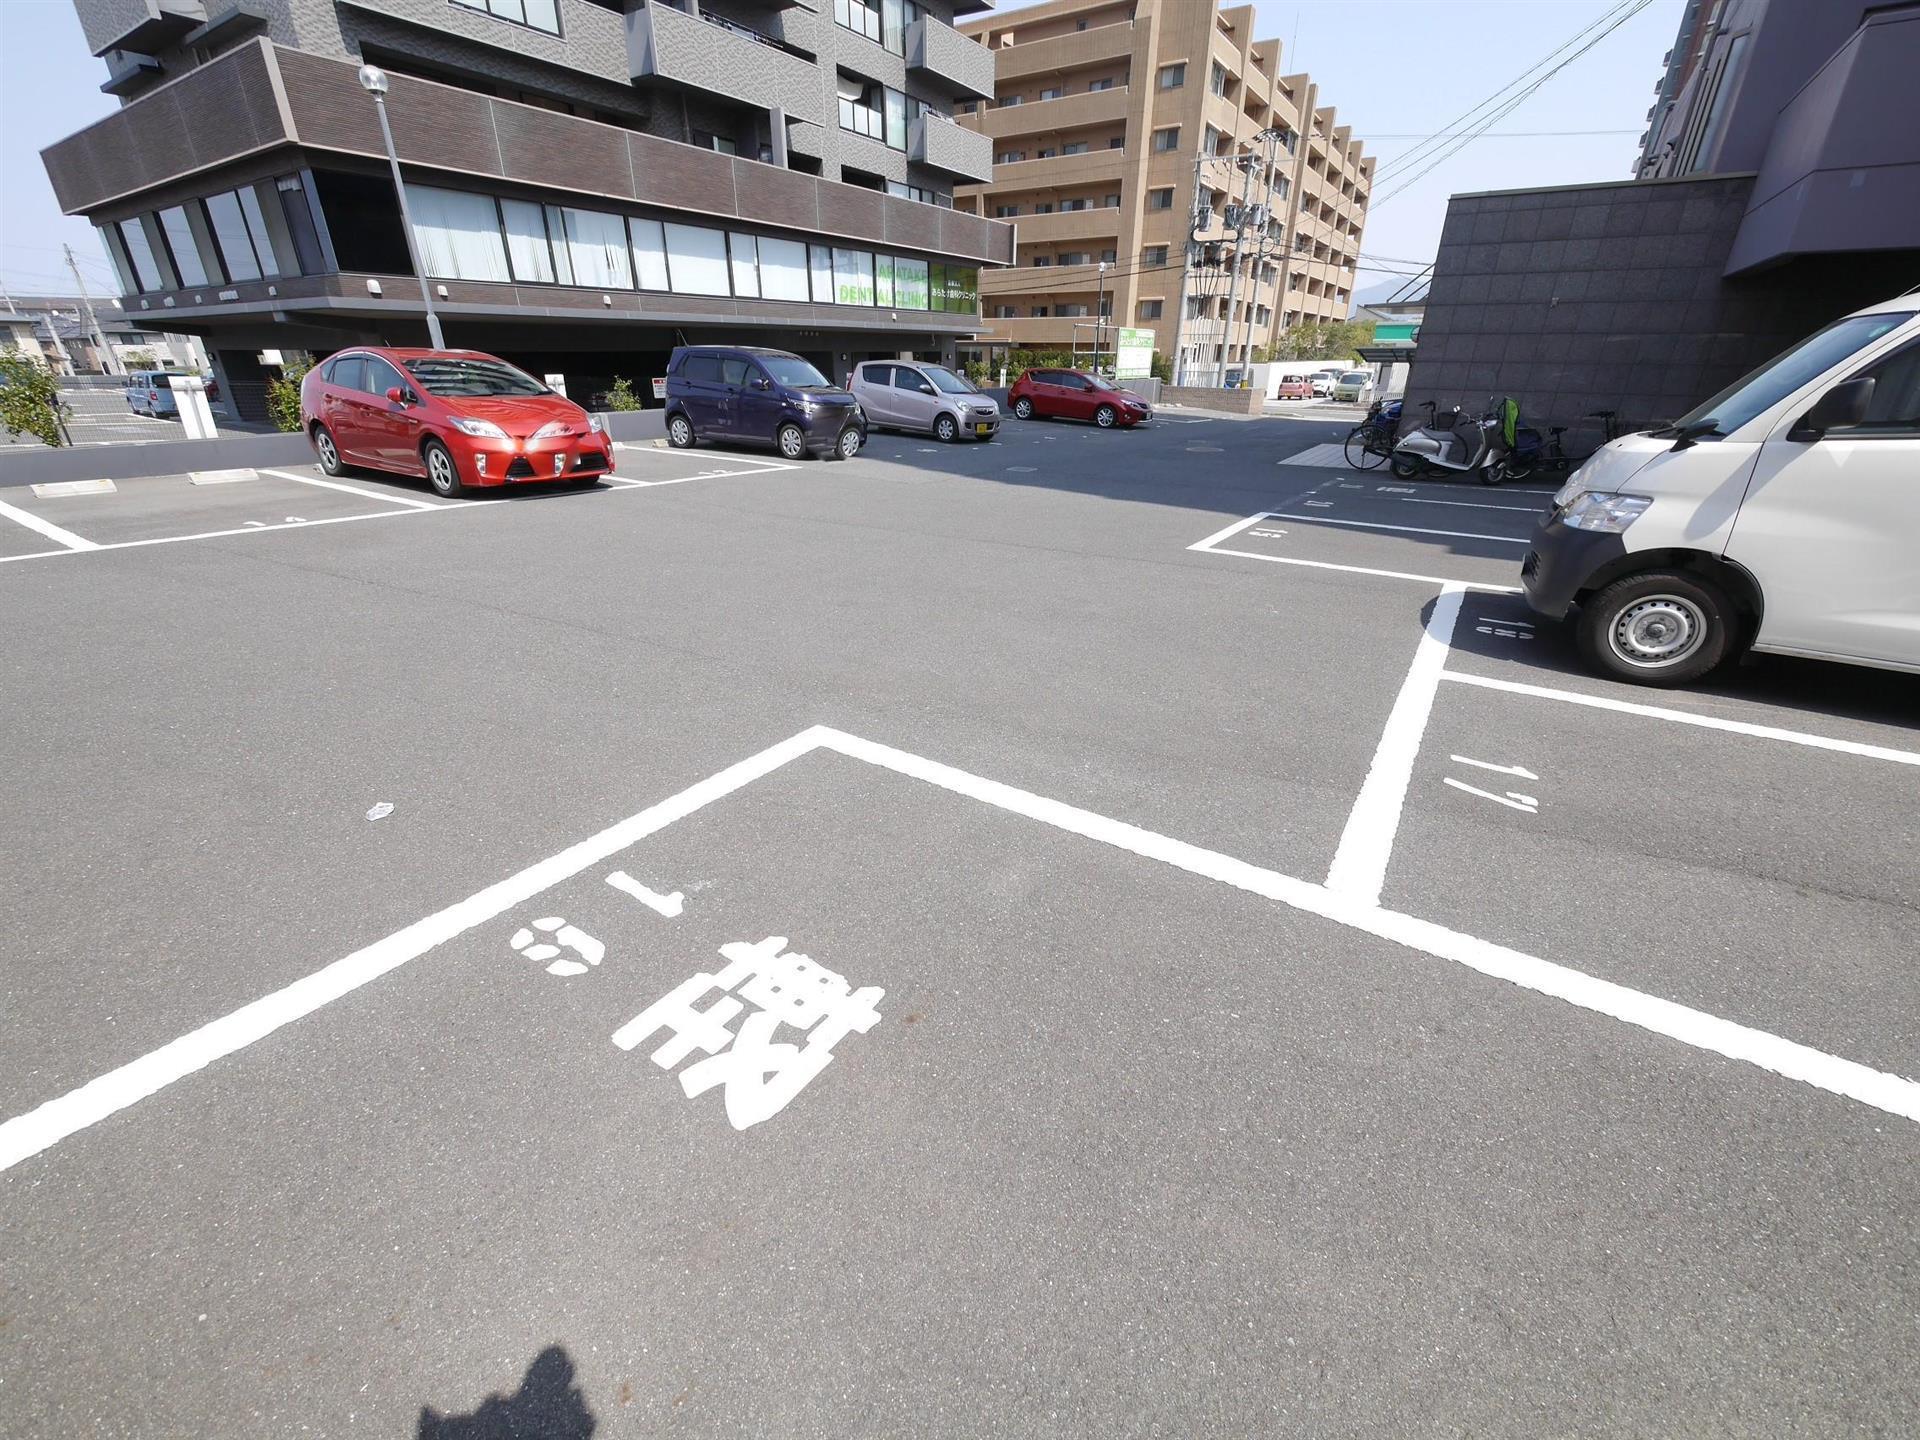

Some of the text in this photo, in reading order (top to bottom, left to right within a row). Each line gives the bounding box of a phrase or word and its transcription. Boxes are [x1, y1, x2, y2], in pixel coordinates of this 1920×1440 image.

[839, 285, 927, 308] DENTAL CLINIC
[1475, 617, 1535, 639] 18
[1443, 754, 1539, 813] 17
[510, 871, 685, 977] 16
[611, 936, 885, 1131] 軽
